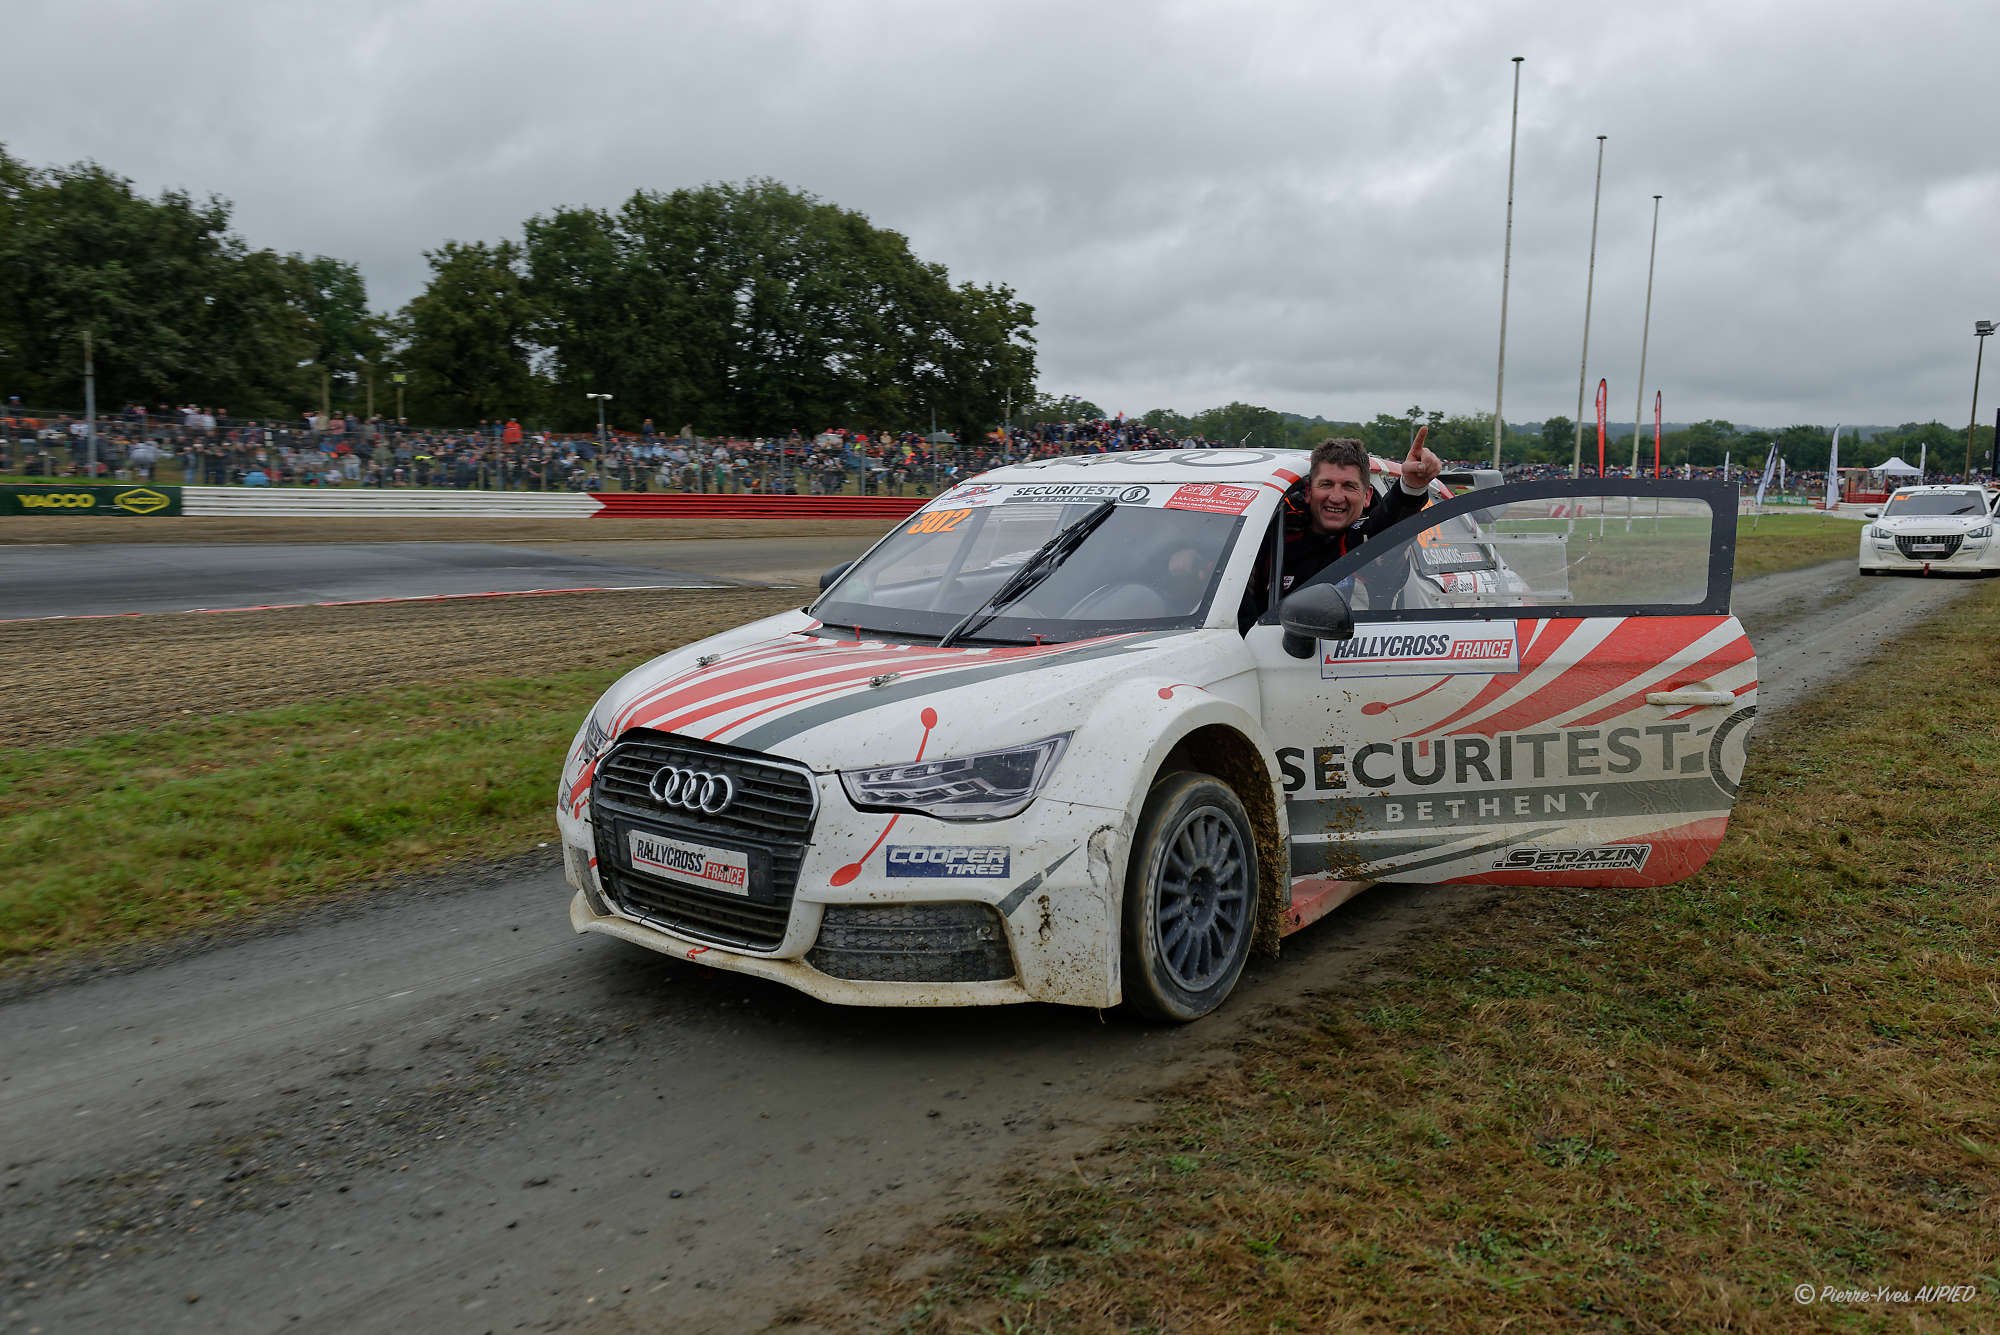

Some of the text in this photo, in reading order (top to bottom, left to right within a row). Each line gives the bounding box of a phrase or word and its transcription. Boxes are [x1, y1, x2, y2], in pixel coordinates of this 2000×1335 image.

[16, 494, 96, 508] YACCO
[1013, 486, 1121, 497] SECURITEST
[907, 508, 972, 534] 302
[1334, 635, 1509, 659] RALLYCROSS FRANCE
[1275, 723, 1690, 792] SECURITEST
[1386, 791, 1599, 823] BETHENY
[636, 840, 744, 884] RALLYCROSS FRANCE
[889, 848, 1008, 864] COOPER
[1494, 847, 1650, 870] SERAZIN
[1533, 861, 1632, 871] COMPETITION
[945, 863, 1004, 875] TIRES
